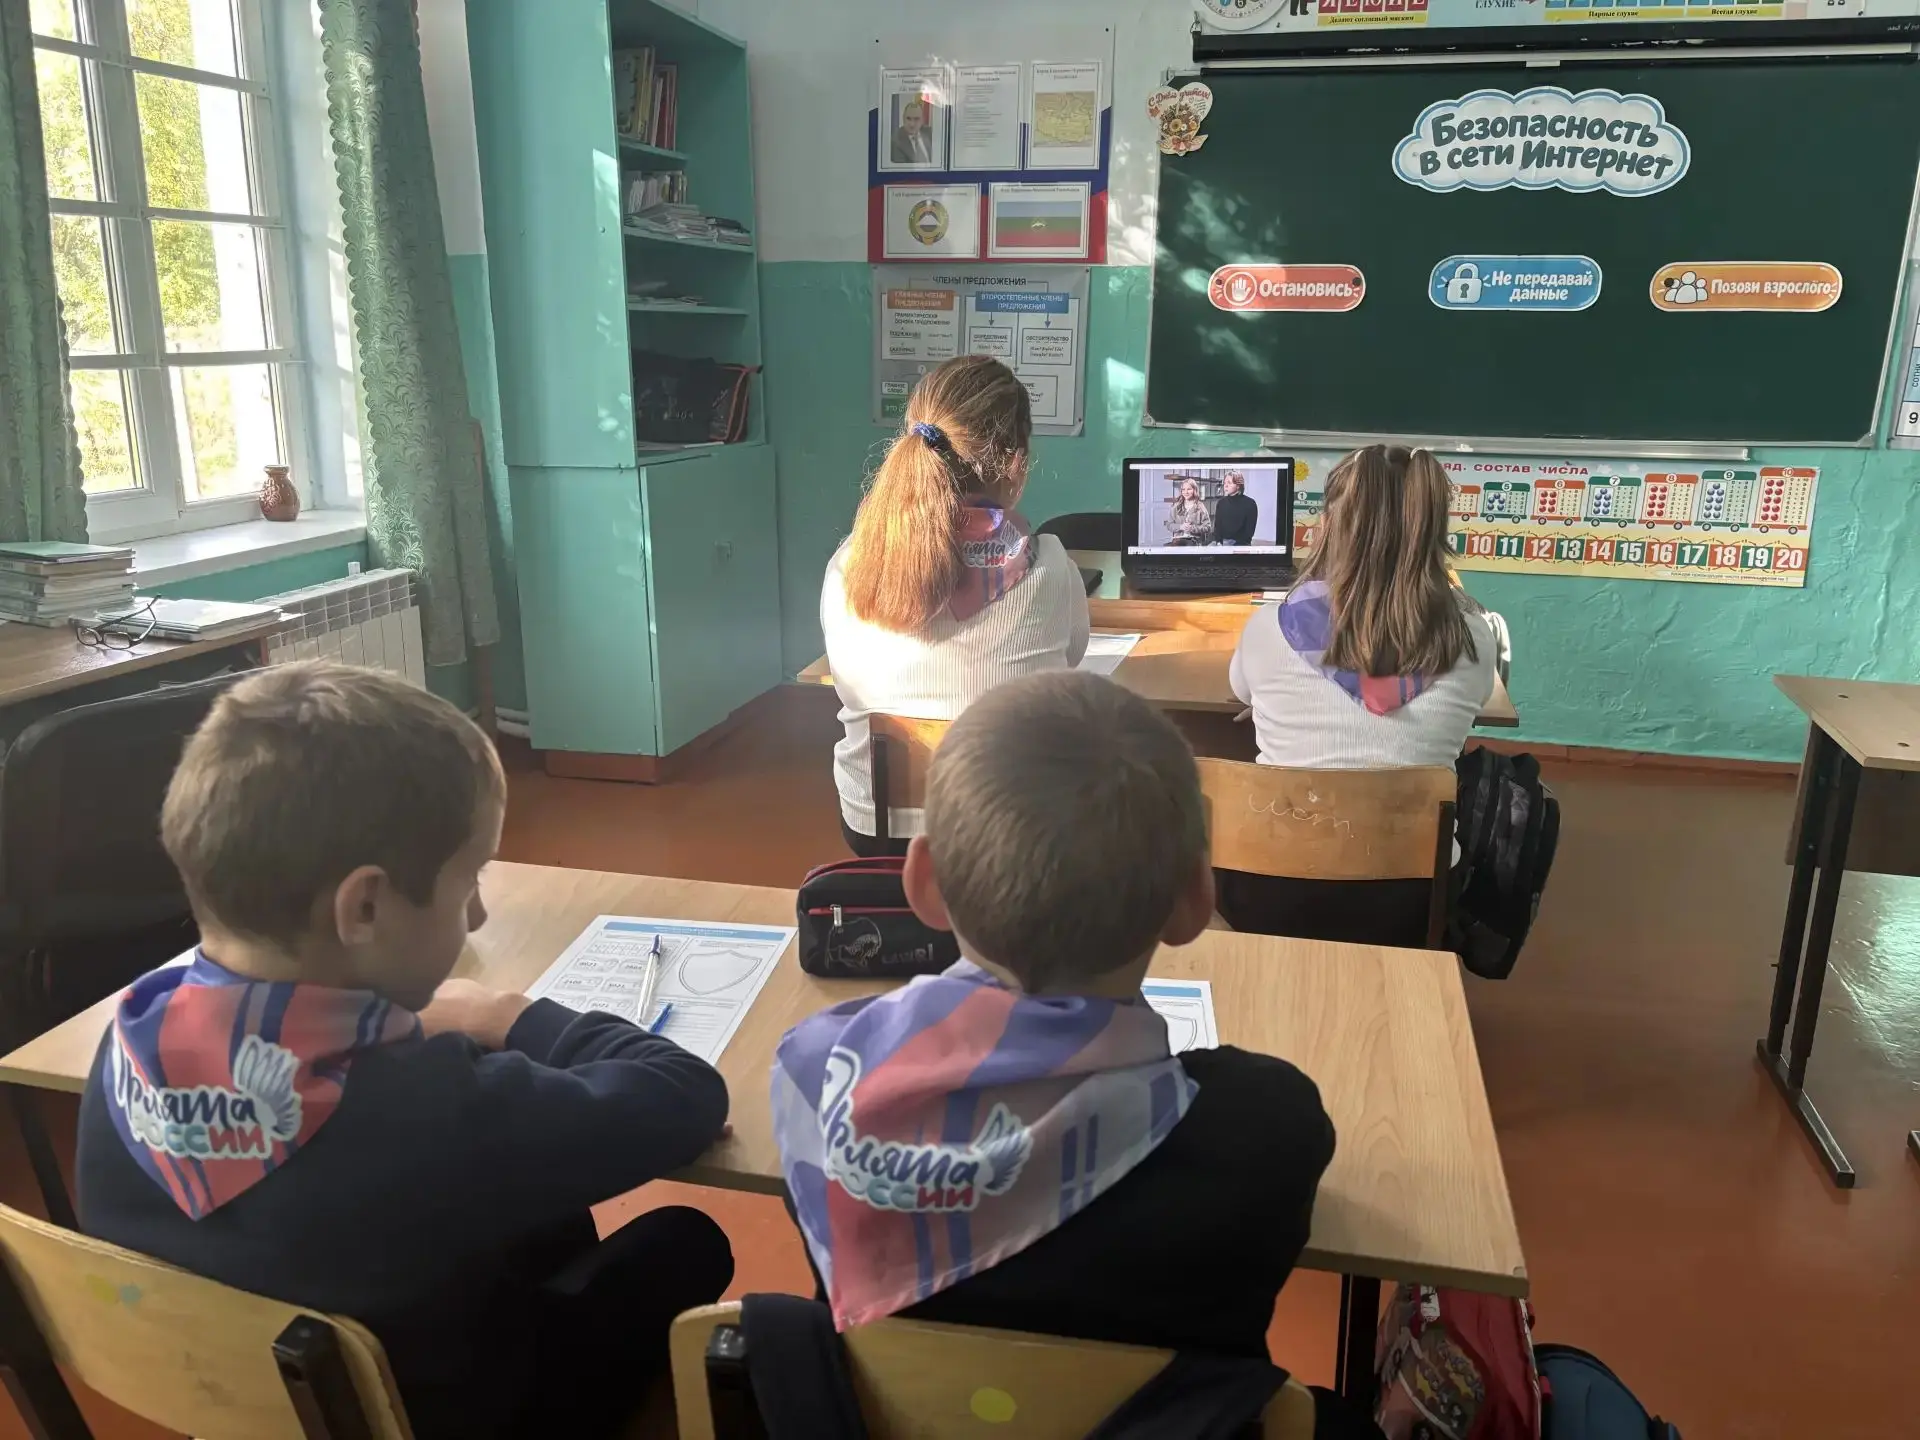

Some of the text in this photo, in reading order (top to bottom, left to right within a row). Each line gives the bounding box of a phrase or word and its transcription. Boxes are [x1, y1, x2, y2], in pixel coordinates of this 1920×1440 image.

[1431, 112, 1659, 148] Безопасность
[1419, 140, 1673, 180] в сети Интернет
[932, 276, 1027, 286] ЧЛЕНЫ ПРЕДЛОЖЕНИЯ
[1259, 279, 1354, 298] Остановись
[1491, 270, 1594, 288] Не передавай
[1711, 279, 1832, 298] Позови взрослого
[981, 294, 1064, 303] ВТОРОСТЕПЕННЫЕ ЧЛЕНЫ
[1509, 287, 1568, 303] данные
[1908, 411, 1919, 424] 9
[1443, 462, 1588, 475] ЯД. СОСТАВ ЧИСЛА
[1302, 531, 1313, 546] 4
[1471, 535, 1491, 554] 10
[1500, 537, 1518, 556] 11
[1531, 538, 1550, 557] 12
[1560, 540, 1581, 559] 13
[1590, 542, 1611, 560] 14
[1620, 541, 1642, 561] 15
[1651, 543, 1672, 563] 16
[1682, 545, 1706, 564] 17
[1714, 547, 1737, 566] 18
[1747, 548, 1769, 567] 19
[1776, 550, 1803, 569] 20
